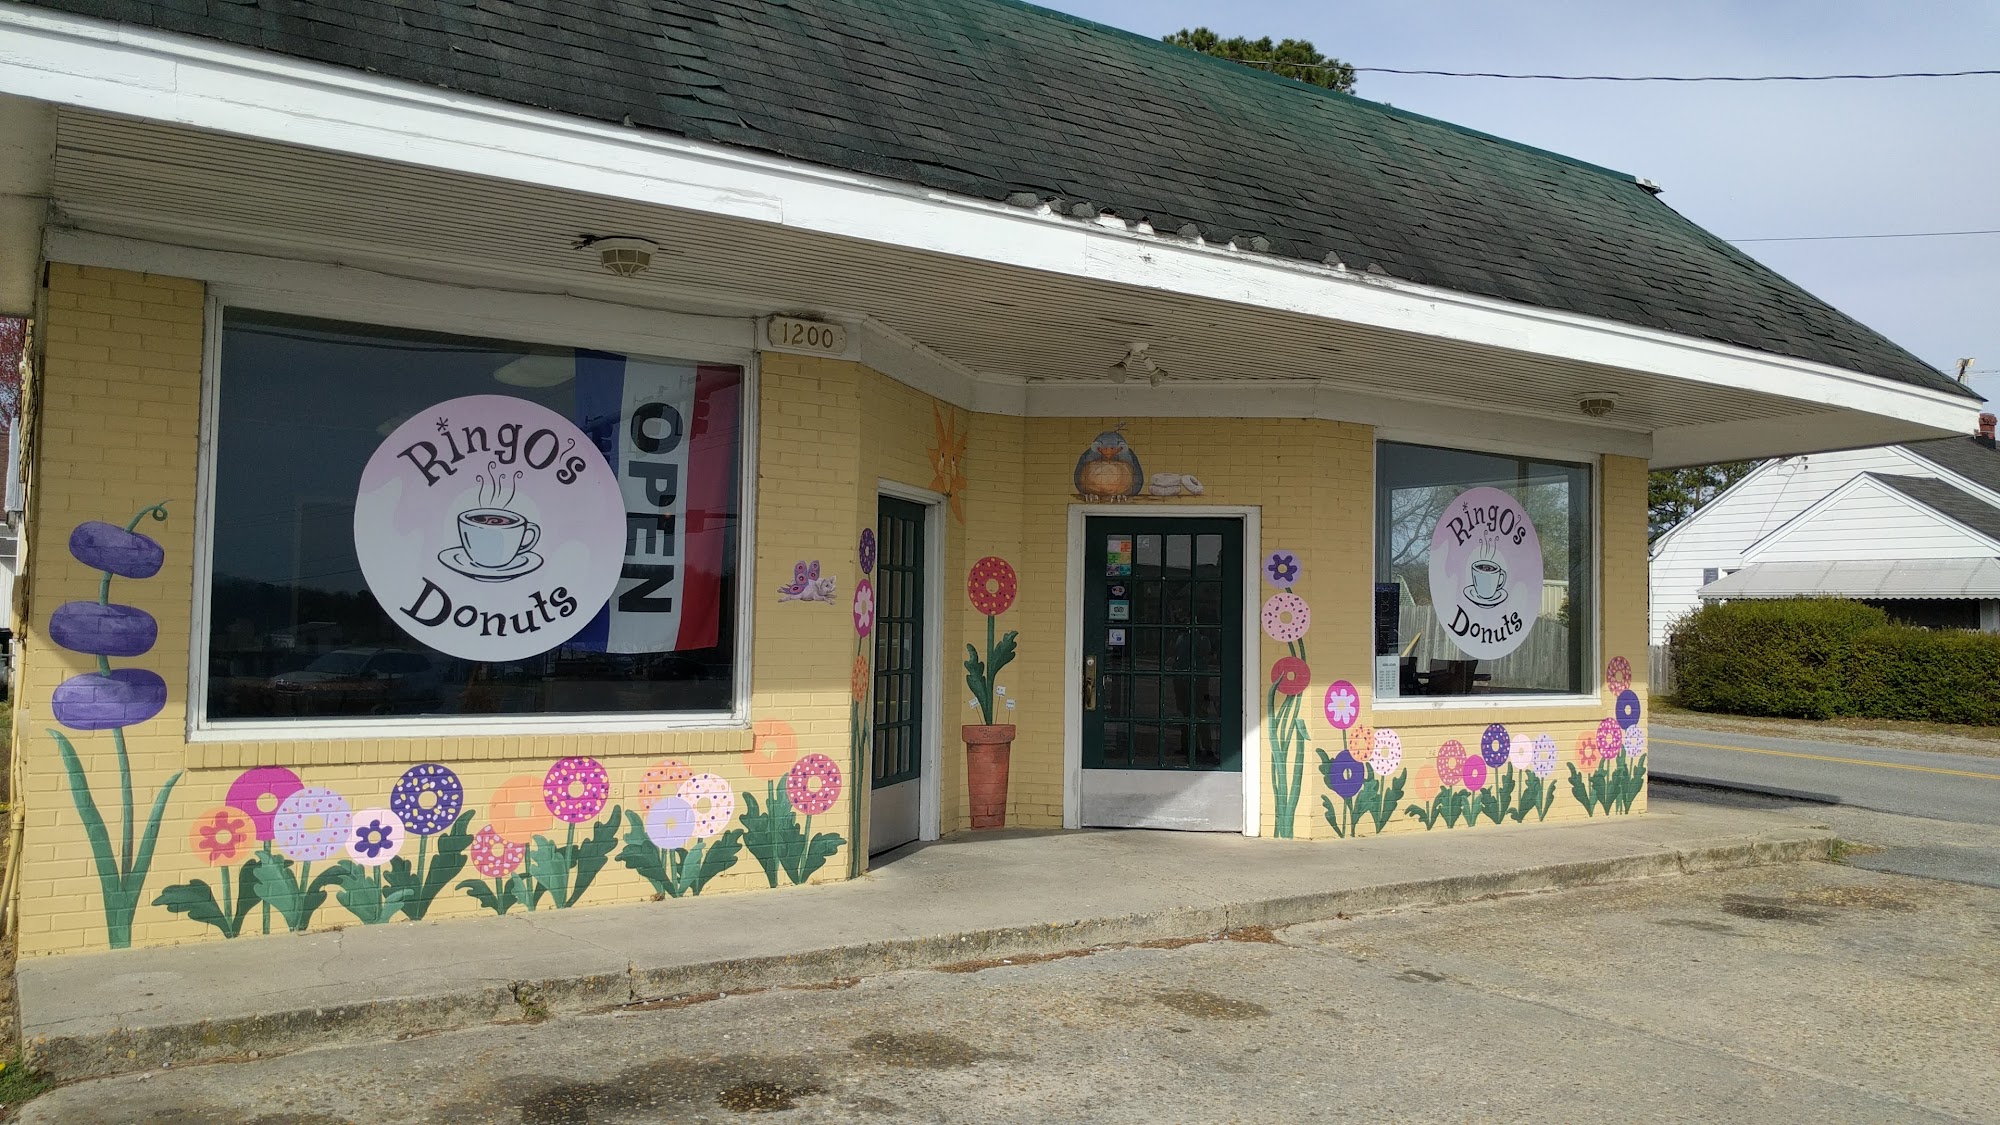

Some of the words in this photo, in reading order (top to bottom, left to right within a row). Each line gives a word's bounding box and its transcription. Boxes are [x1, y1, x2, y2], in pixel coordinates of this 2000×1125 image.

[783, 322, 834, 348] 1200
[618, 402, 684, 613] OPEN
[399, 577, 578, 637] Donuts
[1448, 604, 1523, 644] Donuts
